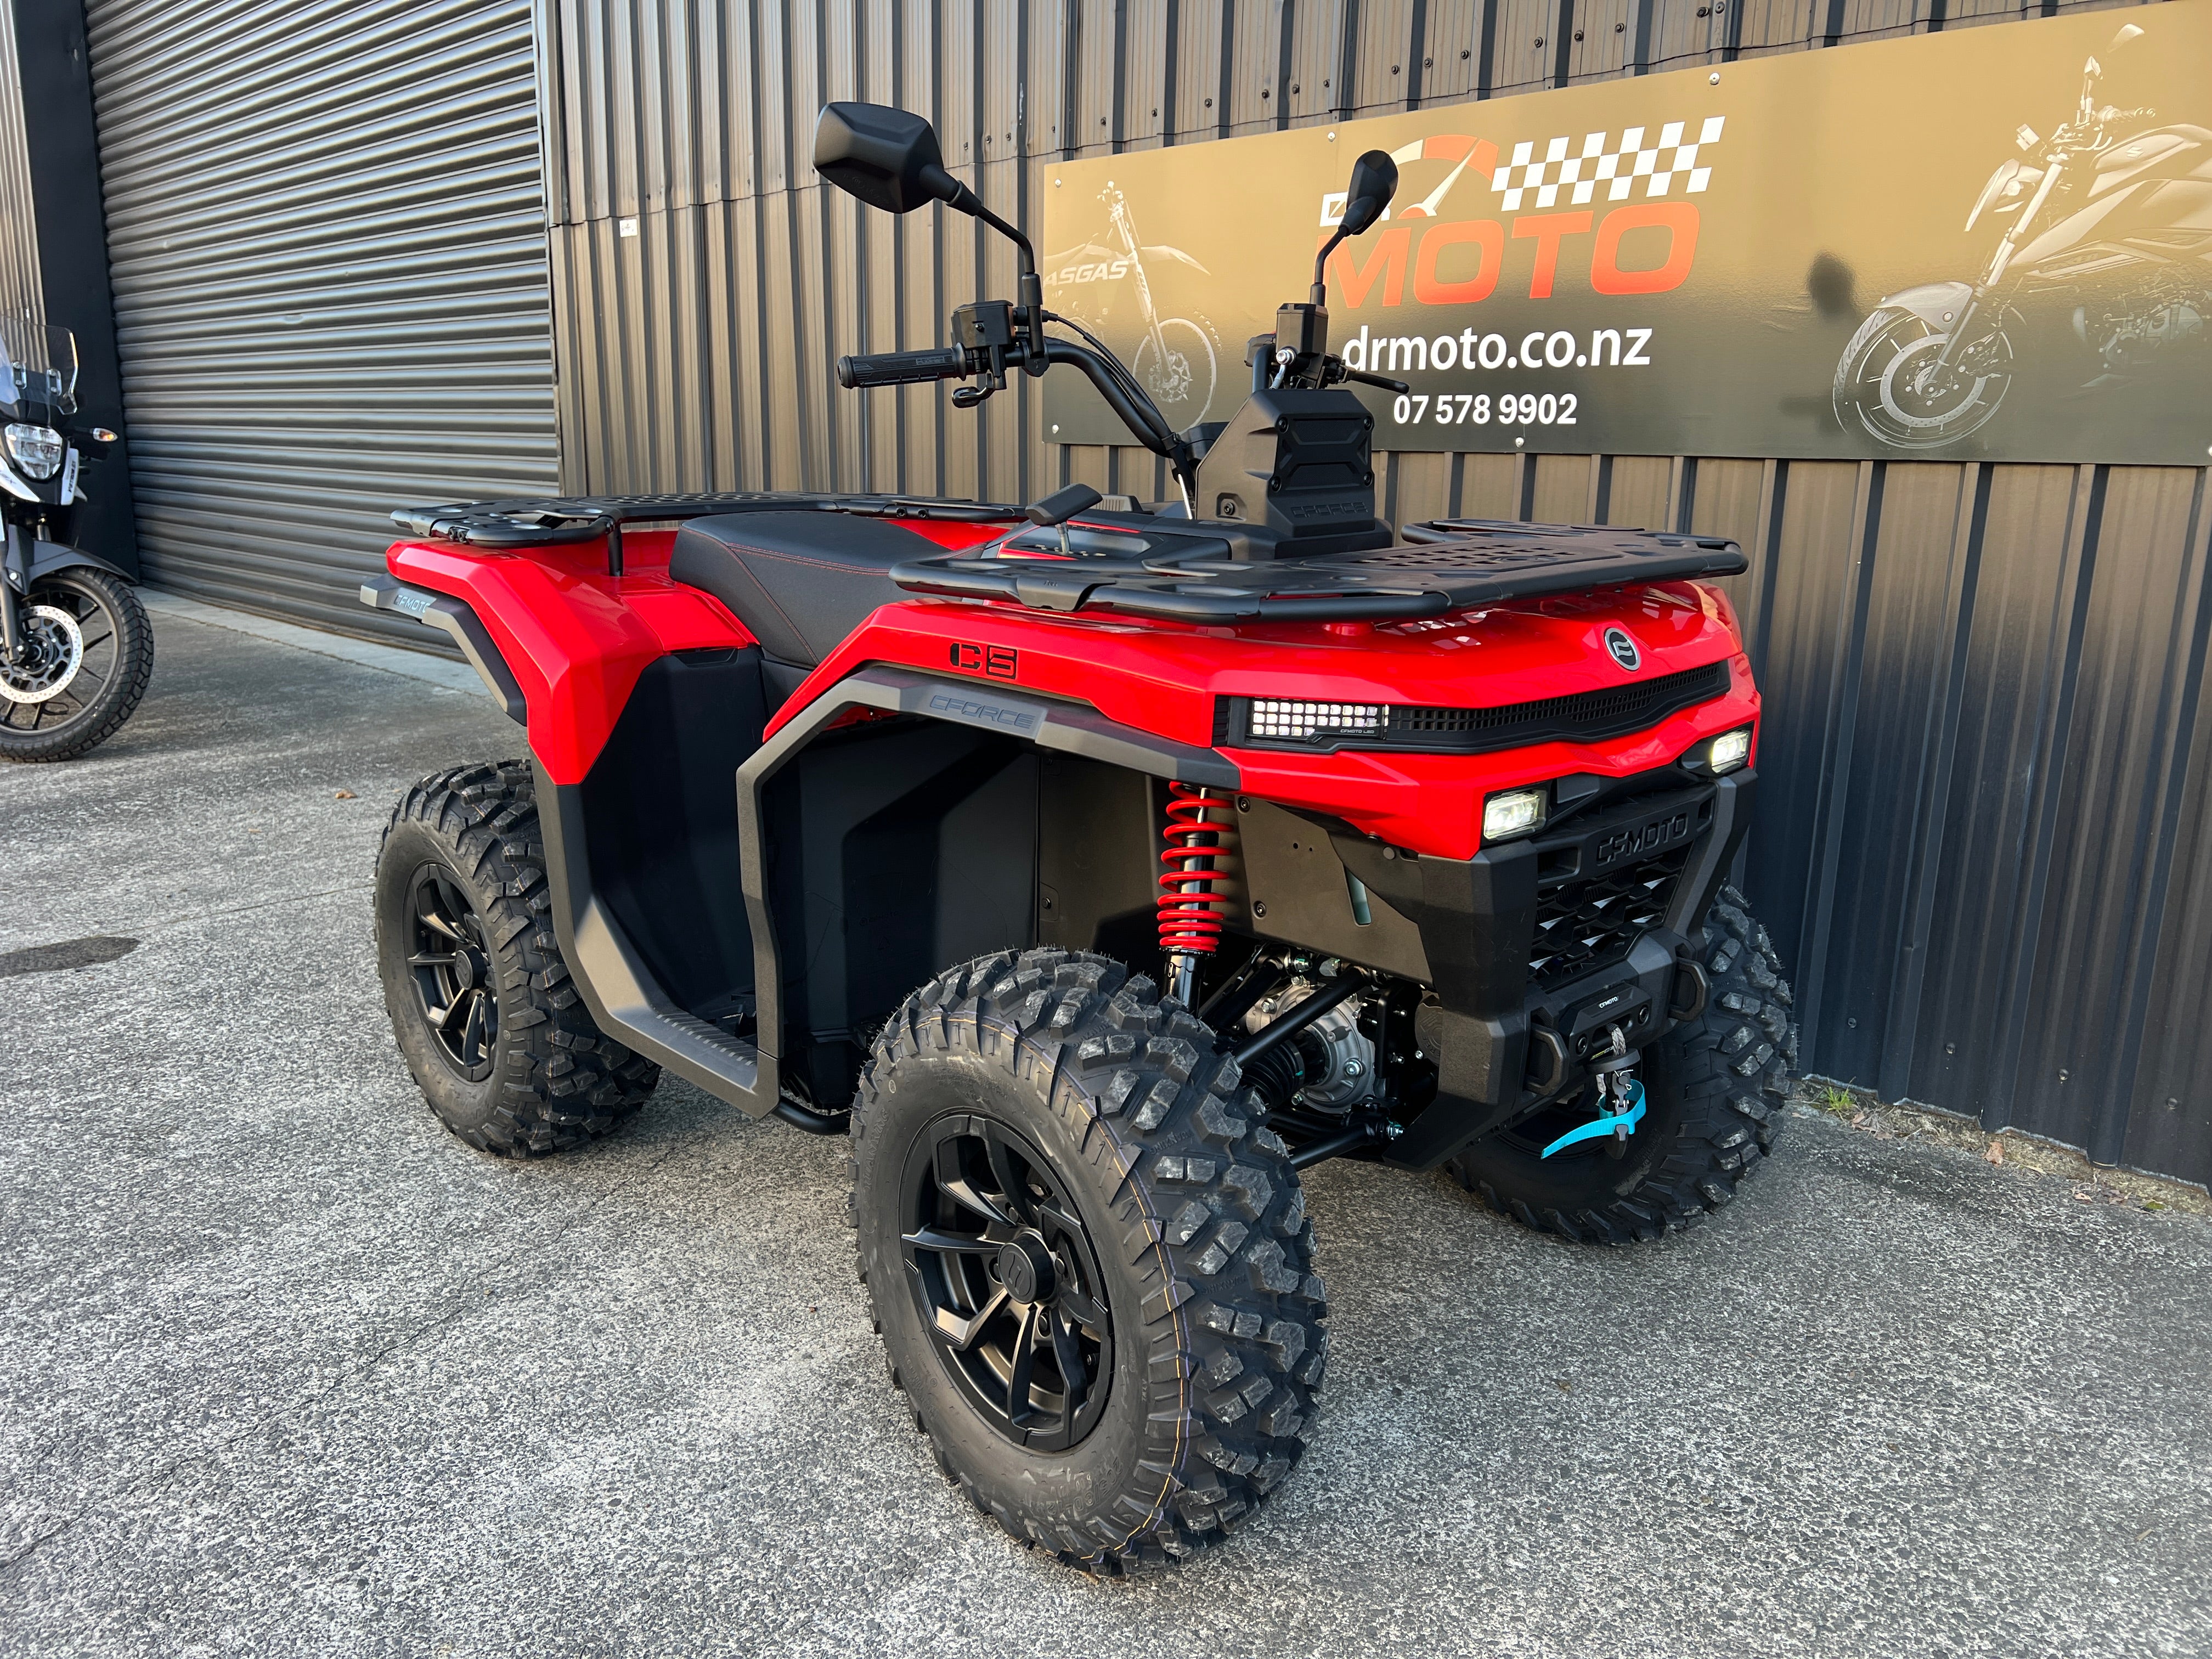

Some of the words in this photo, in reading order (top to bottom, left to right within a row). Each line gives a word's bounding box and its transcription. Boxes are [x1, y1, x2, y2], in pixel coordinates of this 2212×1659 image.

[1312, 201, 1700, 309] MOTO
[1342, 325, 1652, 371] drmoto.co.nz
[1393, 394, 1429, 424] 07
[1435, 394, 1491, 425] 578
[1498, 393, 1577, 425] 9902
[929, 695, 1036, 729] CFORCE
[1596, 812, 1689, 867] CFMOTO
[1599, 996, 1619, 1009] CFMOTO
